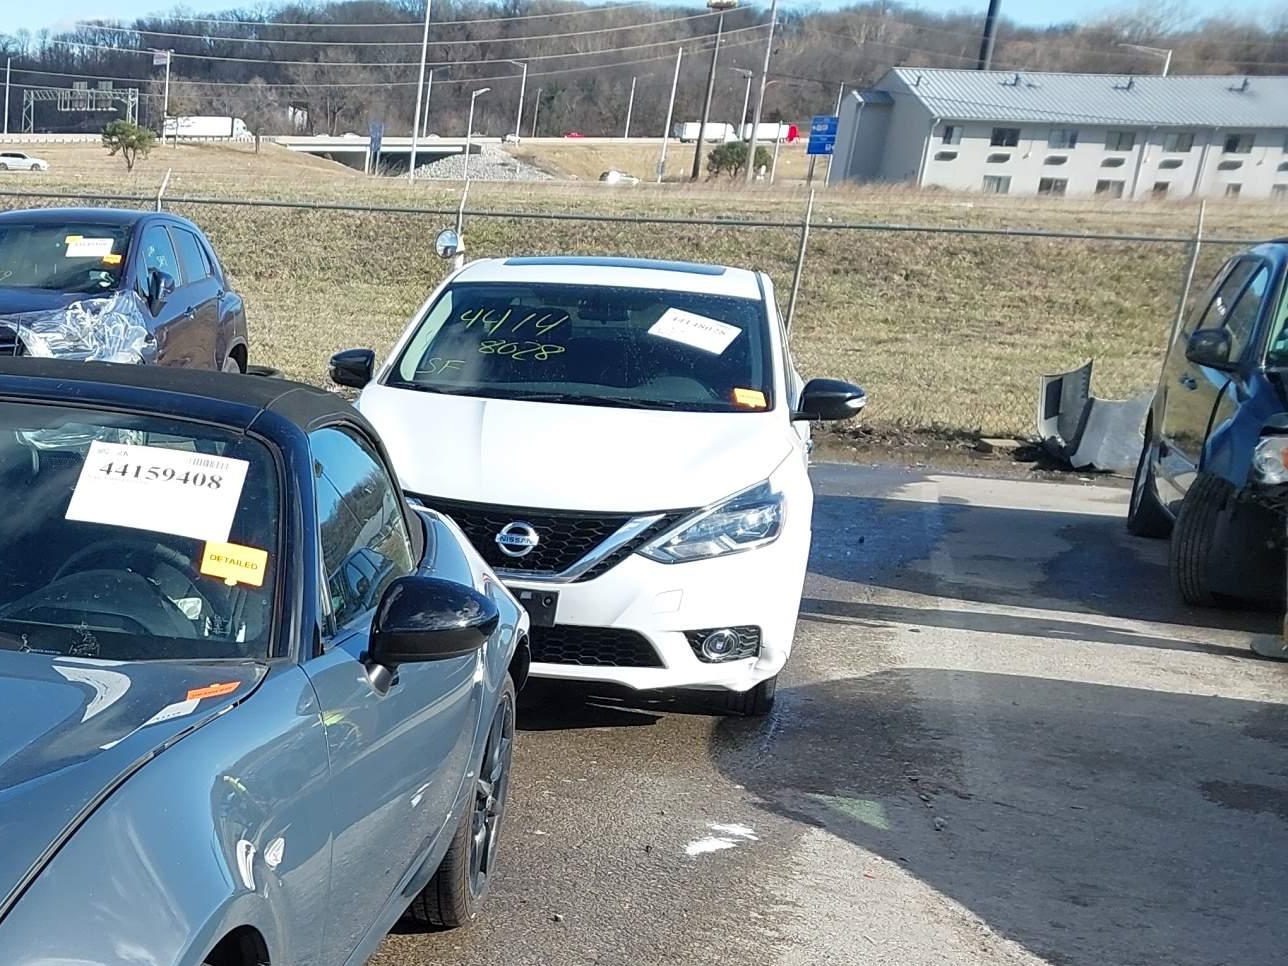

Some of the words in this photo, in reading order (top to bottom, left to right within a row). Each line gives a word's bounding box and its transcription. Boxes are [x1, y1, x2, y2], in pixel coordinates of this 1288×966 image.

[478, 340, 566, 361] 8028
[416, 357, 465, 375] SF
[99, 461, 224, 491] 44159408
[499, 534, 534, 546] NISSAN
[209, 553, 259, 571] DETAILED
